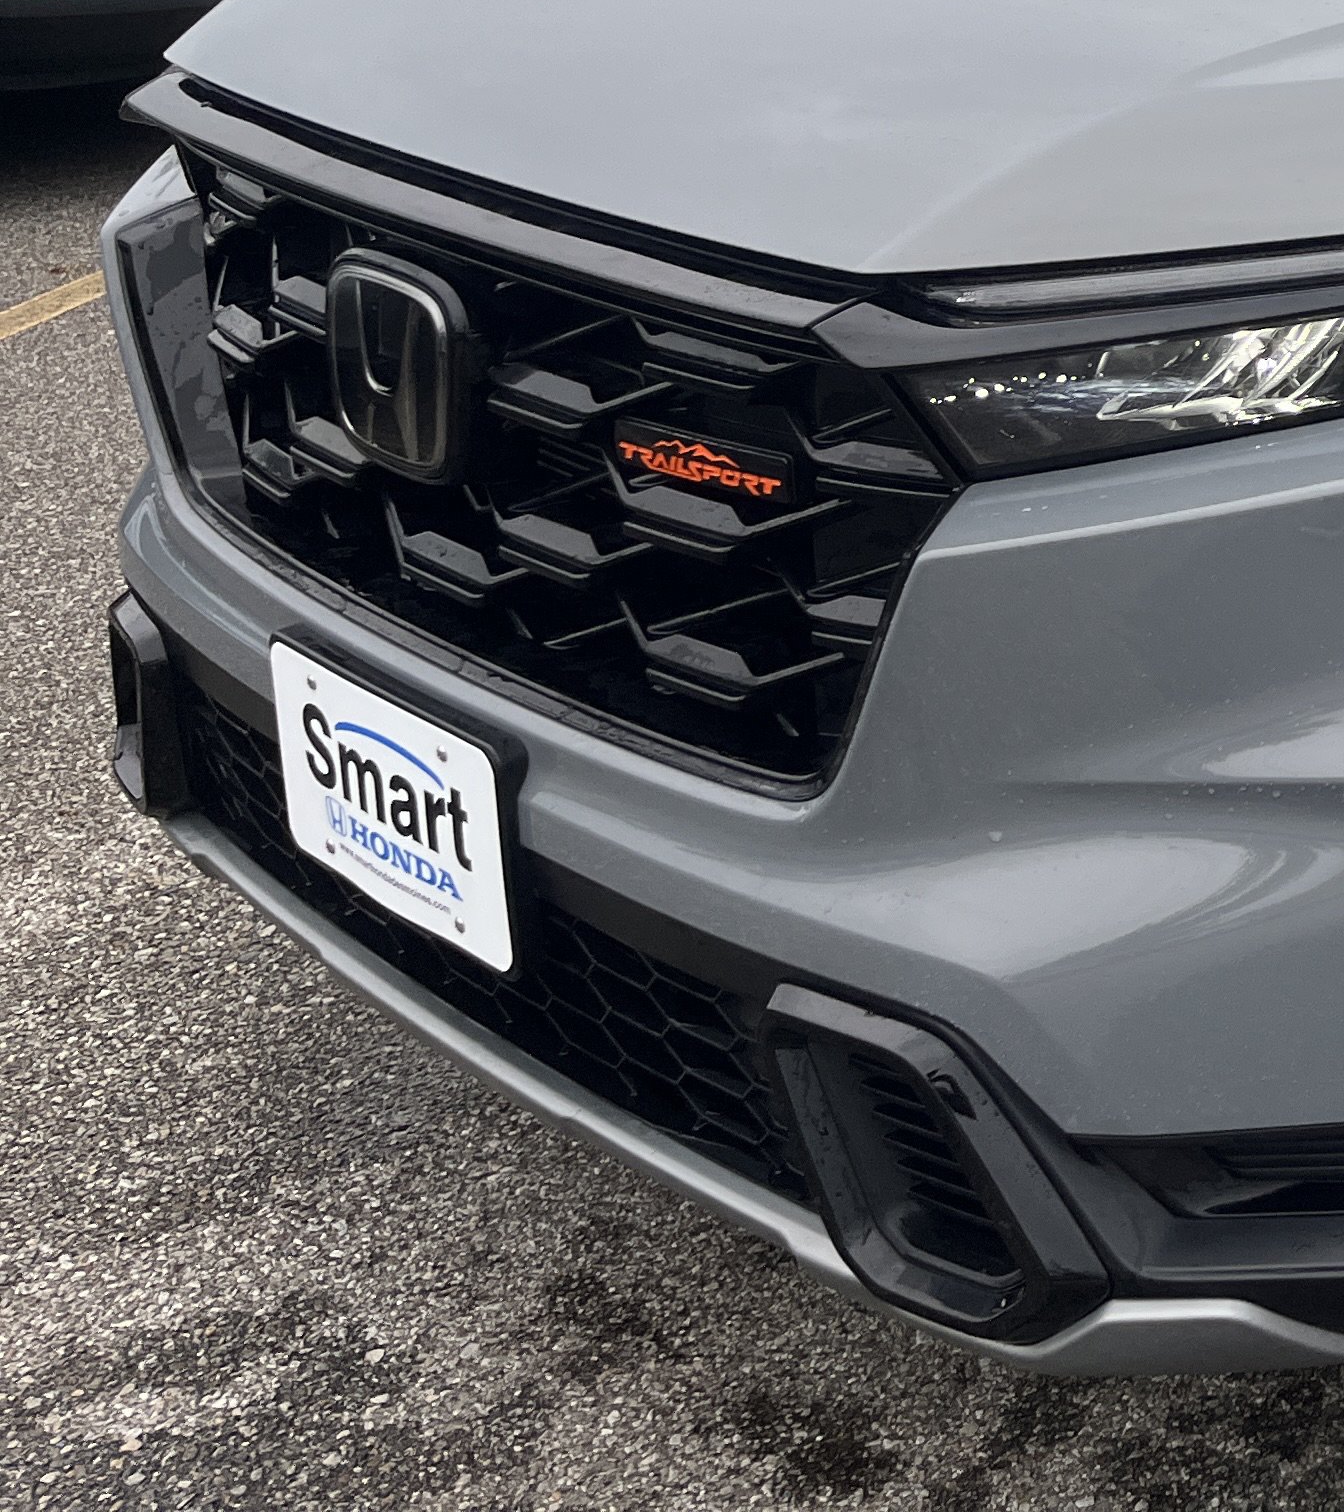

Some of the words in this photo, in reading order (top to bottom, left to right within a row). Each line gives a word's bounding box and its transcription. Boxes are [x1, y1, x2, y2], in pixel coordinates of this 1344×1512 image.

[617, 441, 782, 497] TRAILSPORT
[301, 702, 473, 872] Smart
[348, 815, 464, 902] HONDA
